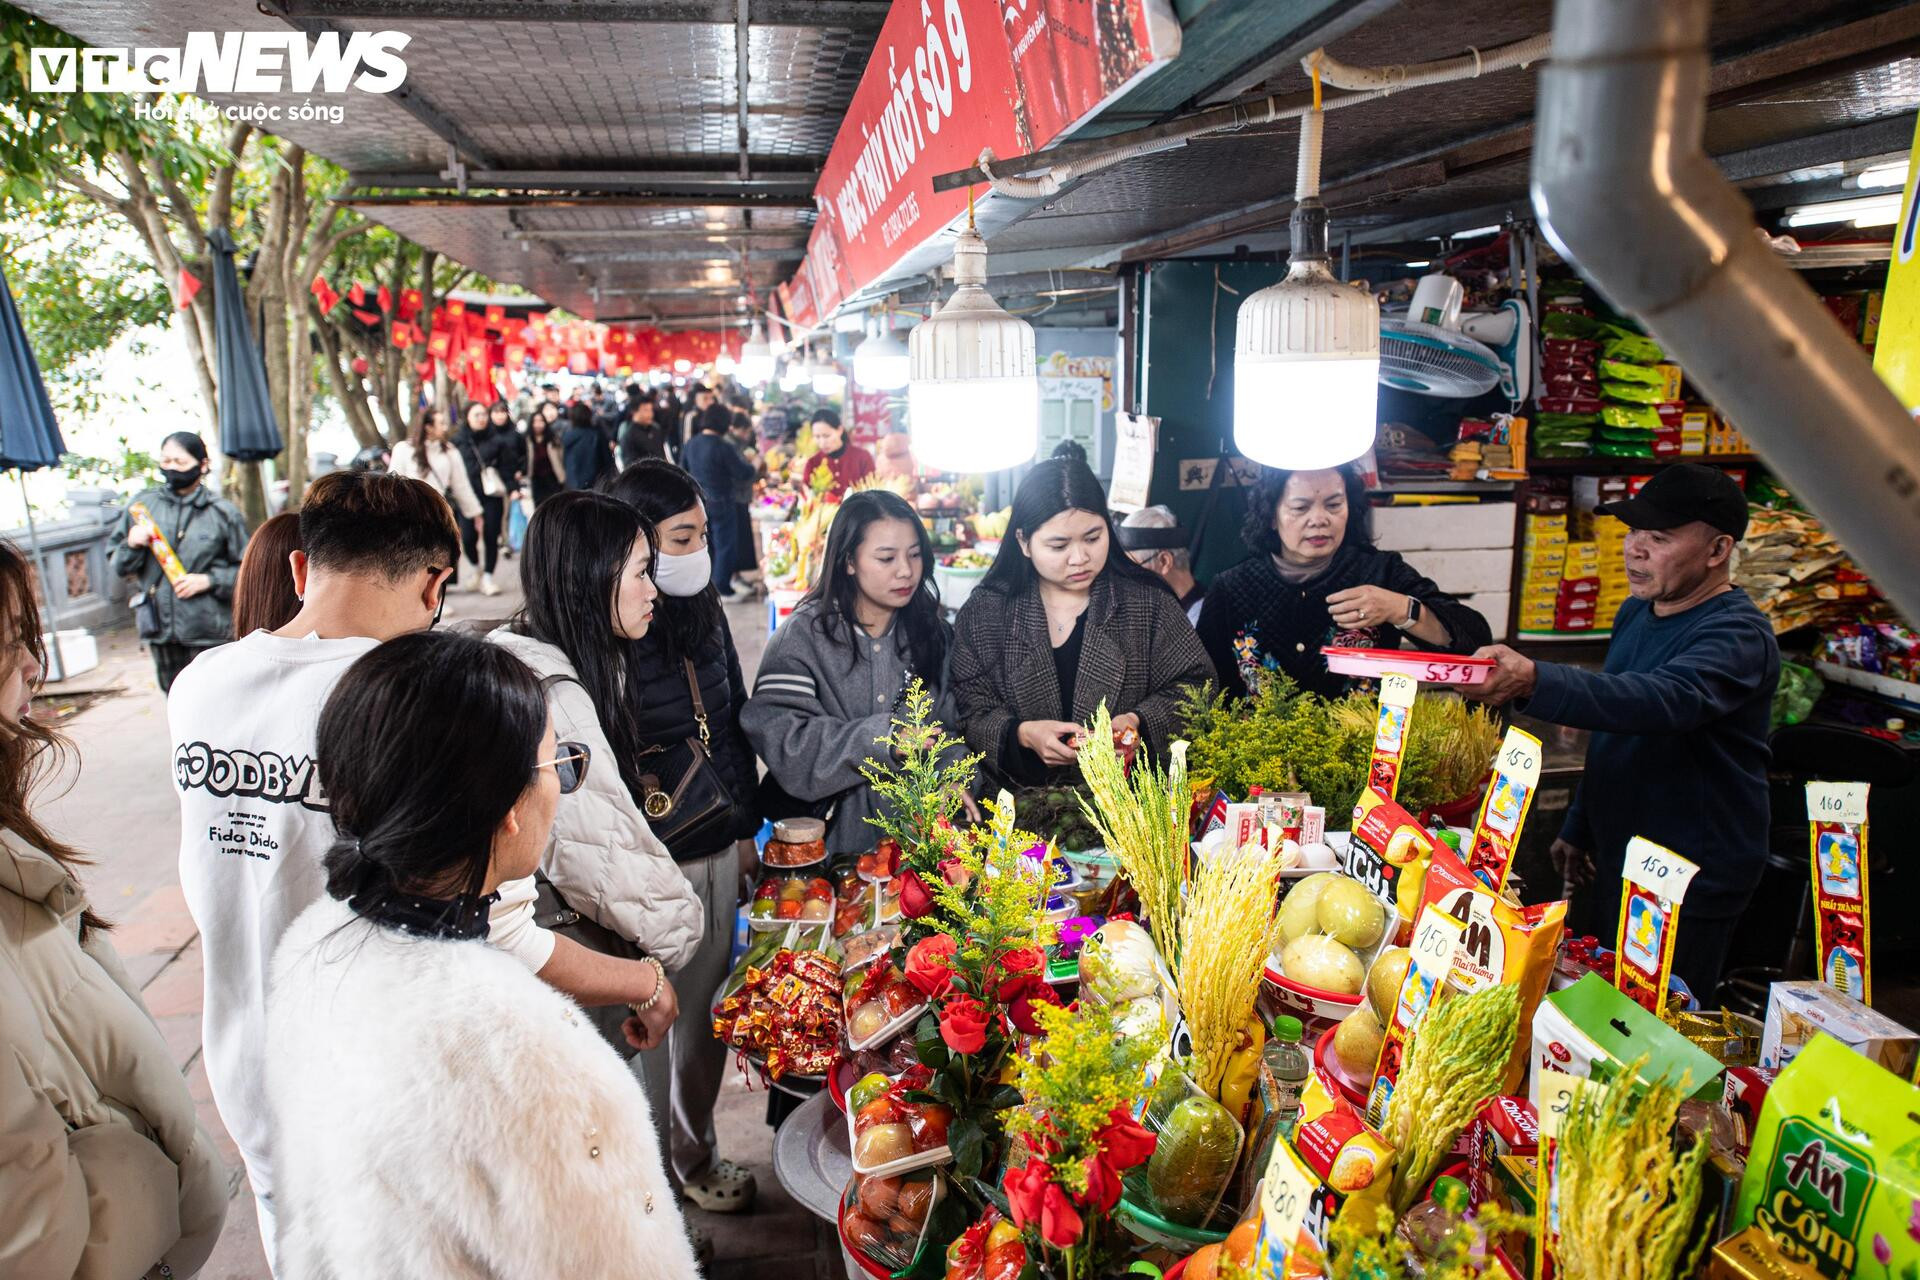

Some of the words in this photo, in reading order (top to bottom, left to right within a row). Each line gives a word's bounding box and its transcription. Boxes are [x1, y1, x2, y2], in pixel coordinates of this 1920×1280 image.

[880, 46, 925, 183] KIỐT
[944, 0, 973, 94] 9
[1506, 747, 1533, 770] 150
[209, 826, 246, 843] Fido
[249, 831, 279, 850] Dido
[1640, 855, 1669, 879] 150
[1419, 922, 1448, 958] 150
[1452, 956, 1472, 971] Mai
[1782, 1138, 1847, 1217] An
[1772, 1189, 1856, 1271] Cốm
